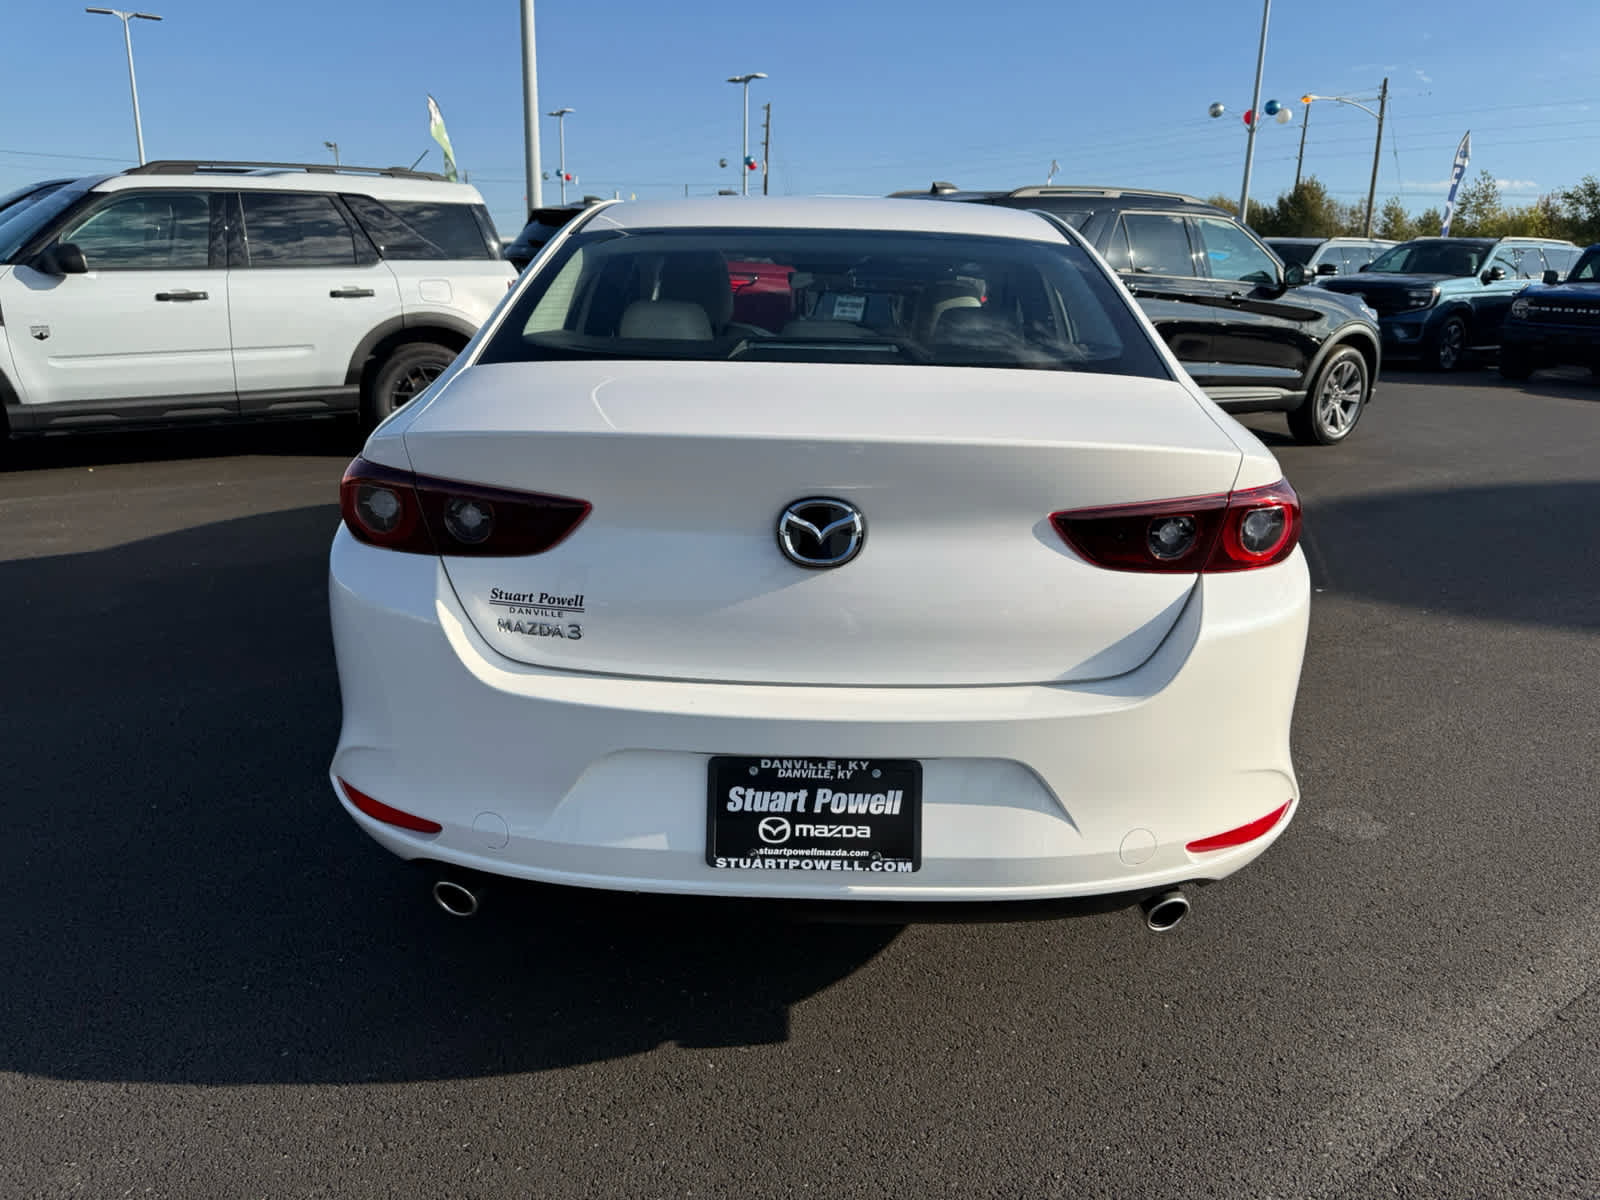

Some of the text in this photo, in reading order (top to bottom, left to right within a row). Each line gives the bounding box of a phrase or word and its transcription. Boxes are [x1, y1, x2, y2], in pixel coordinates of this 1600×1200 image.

[490, 587, 585, 607] Stuart Powell
[509, 606, 564, 618] DANVILLE
[848, 760, 870, 771] KY
[777, 769, 854, 781] DANVILLE, KY
[726, 786, 904, 816] Stuart Powell
[794, 823, 872, 839] mazda
[758, 847, 870, 858] stuartpowellmazda.com
[715, 857, 913, 873] STUARTPOWELL.COM
